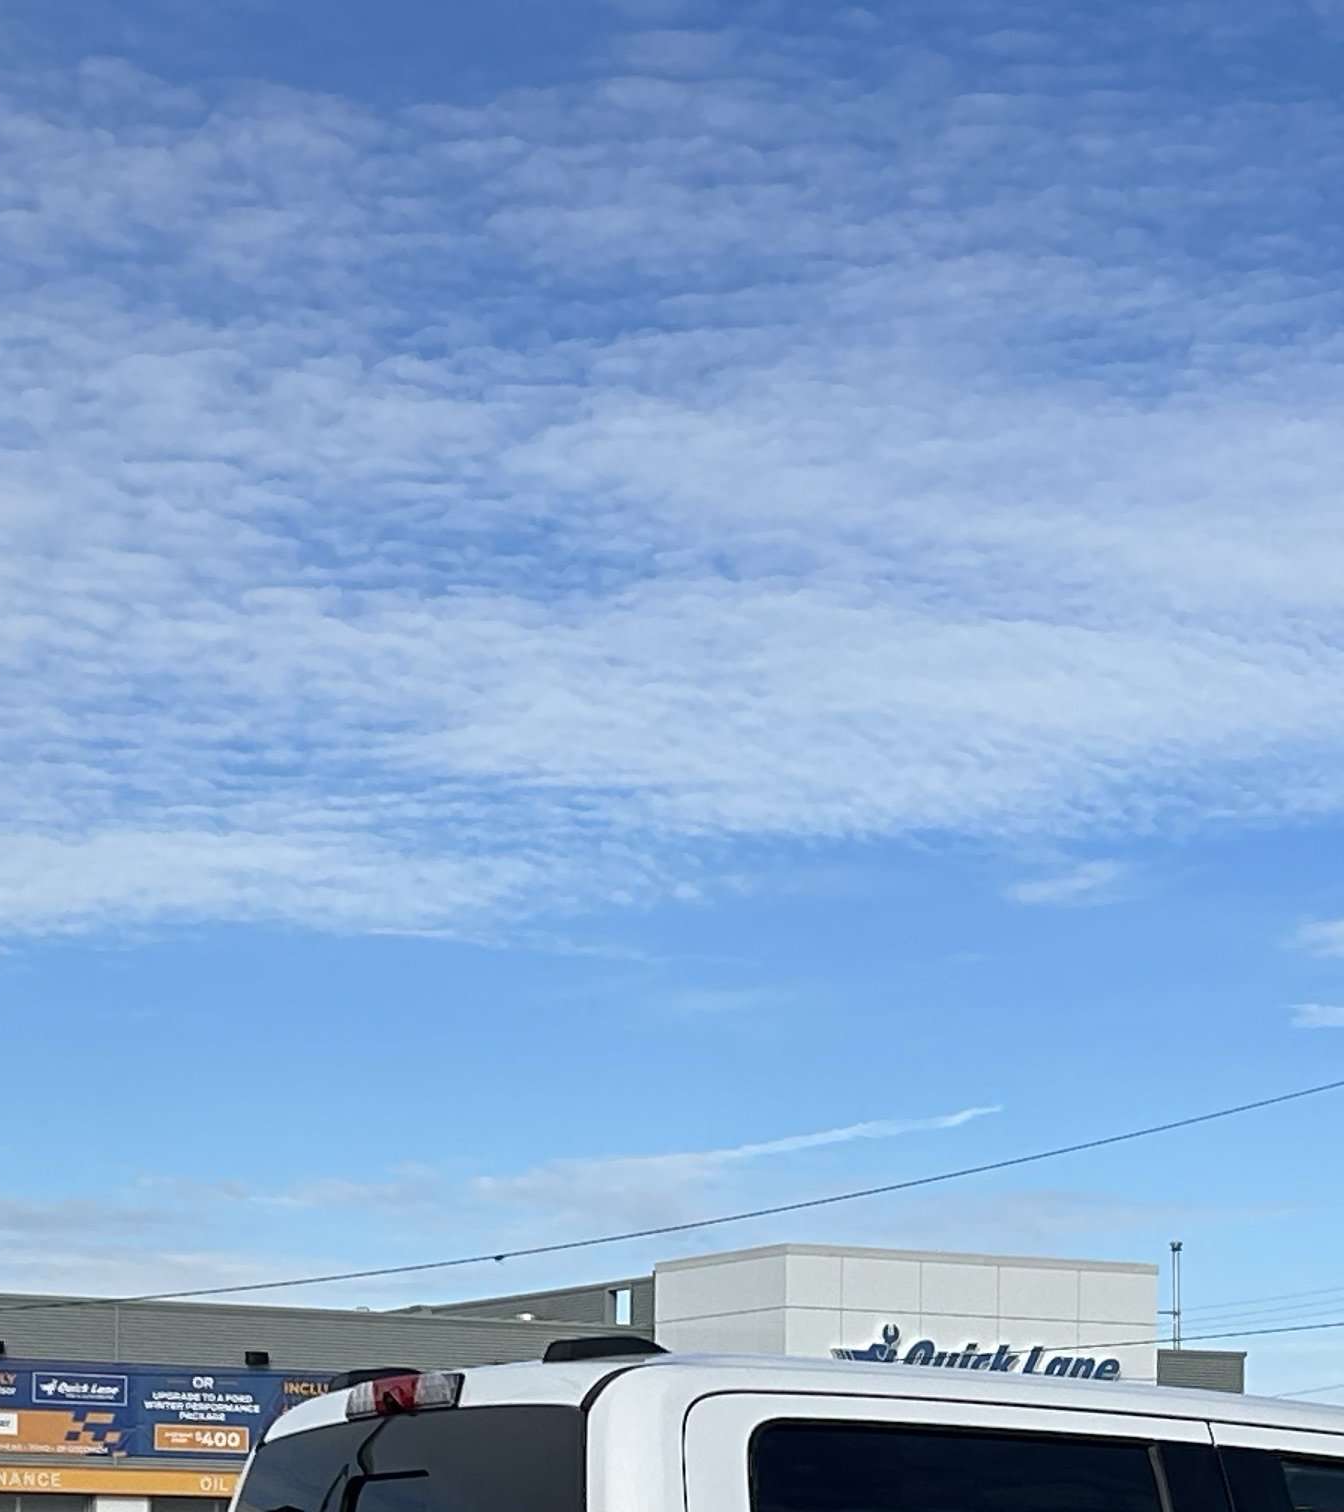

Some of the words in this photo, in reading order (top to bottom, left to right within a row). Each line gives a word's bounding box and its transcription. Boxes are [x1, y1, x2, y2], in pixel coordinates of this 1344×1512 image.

[192, 1376, 215, 1389] OR
[195, 1431, 241, 1447] $400
[199, 1476, 229, 1491] OIL
